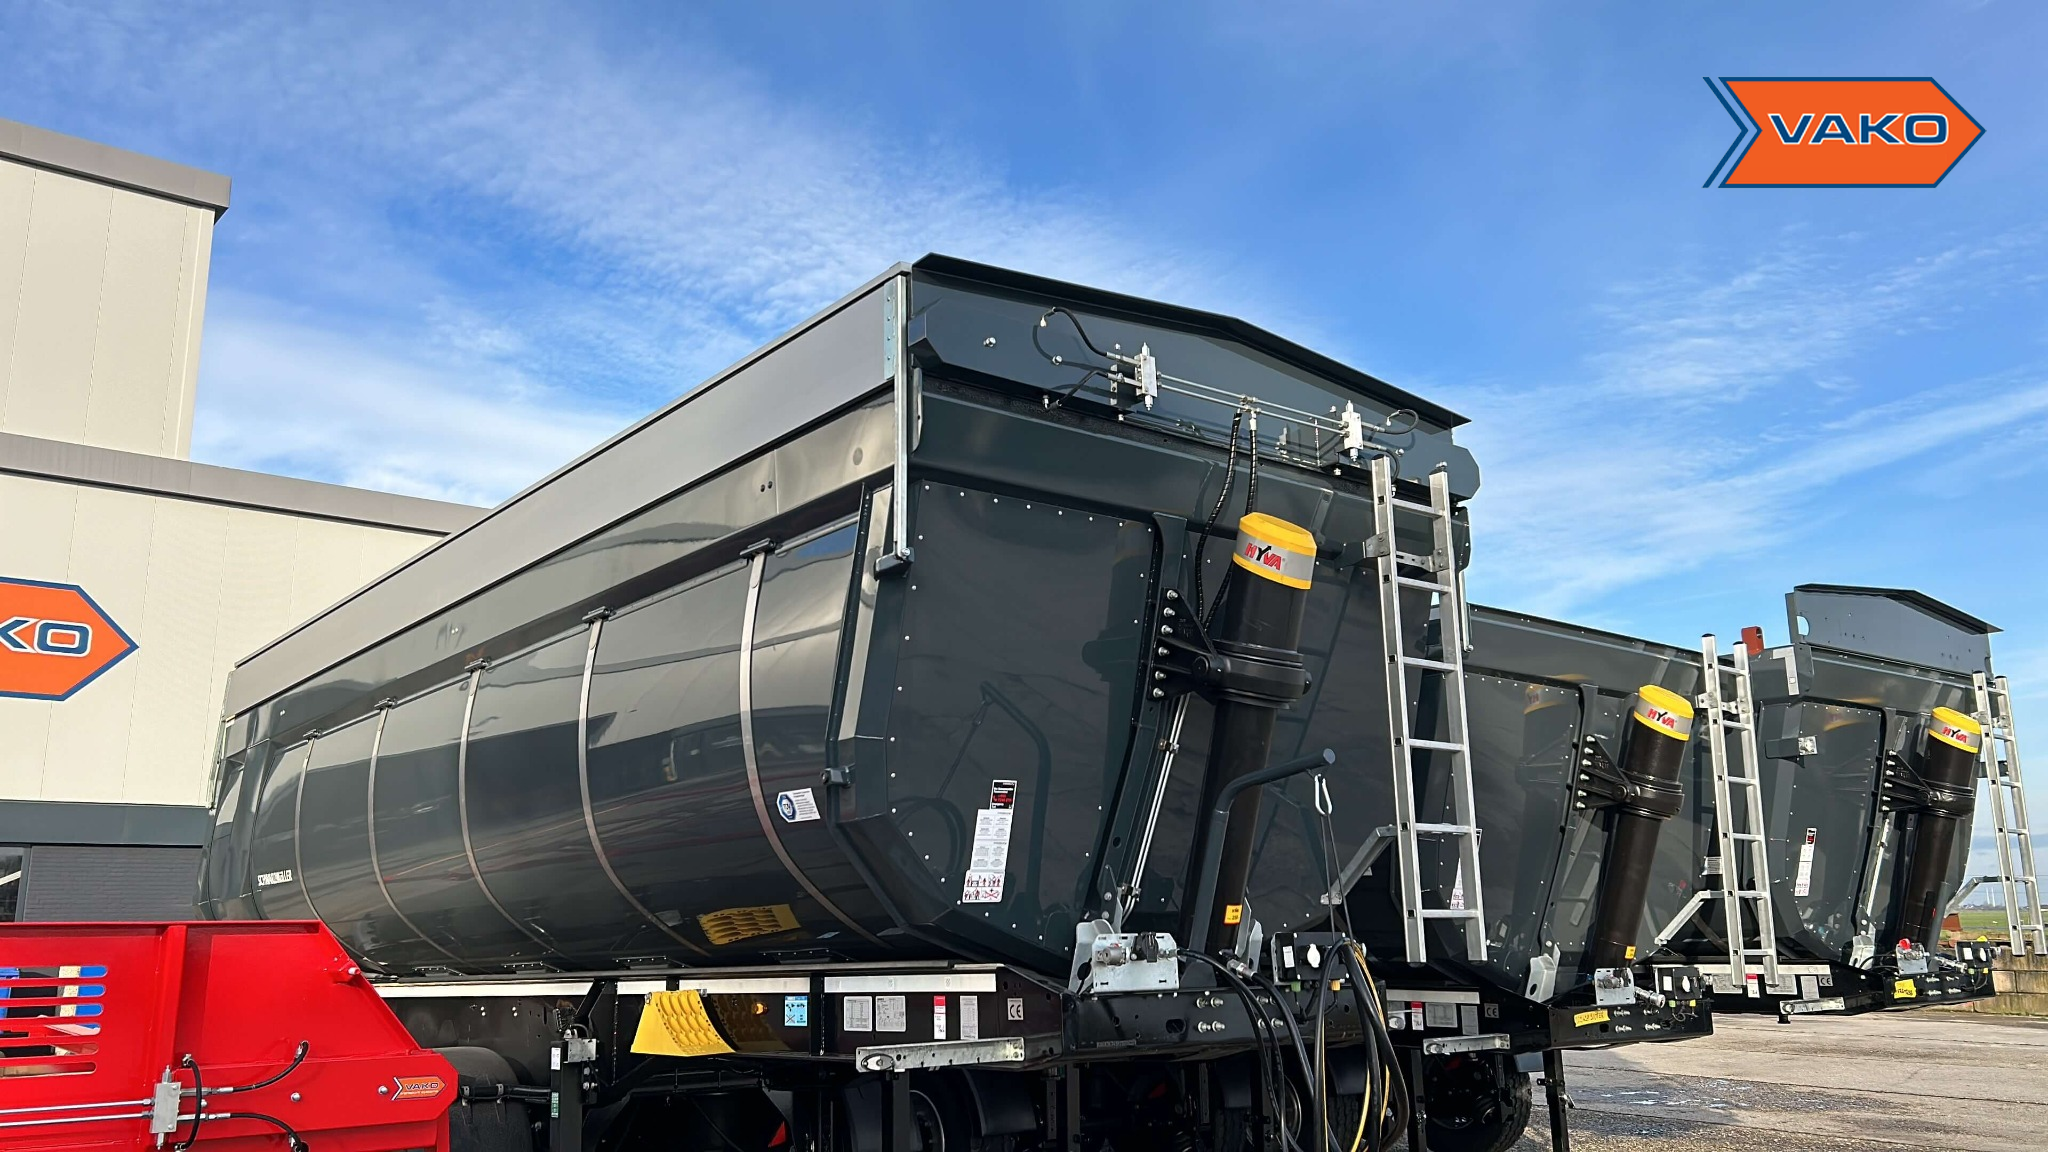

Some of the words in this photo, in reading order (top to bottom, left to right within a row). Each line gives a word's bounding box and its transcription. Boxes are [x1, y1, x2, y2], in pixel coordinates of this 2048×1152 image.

[1245, 542, 1281, 571] HYVA
[1647, 708, 1675, 729] HYVA
[1942, 726, 1967, 743] HYVA
